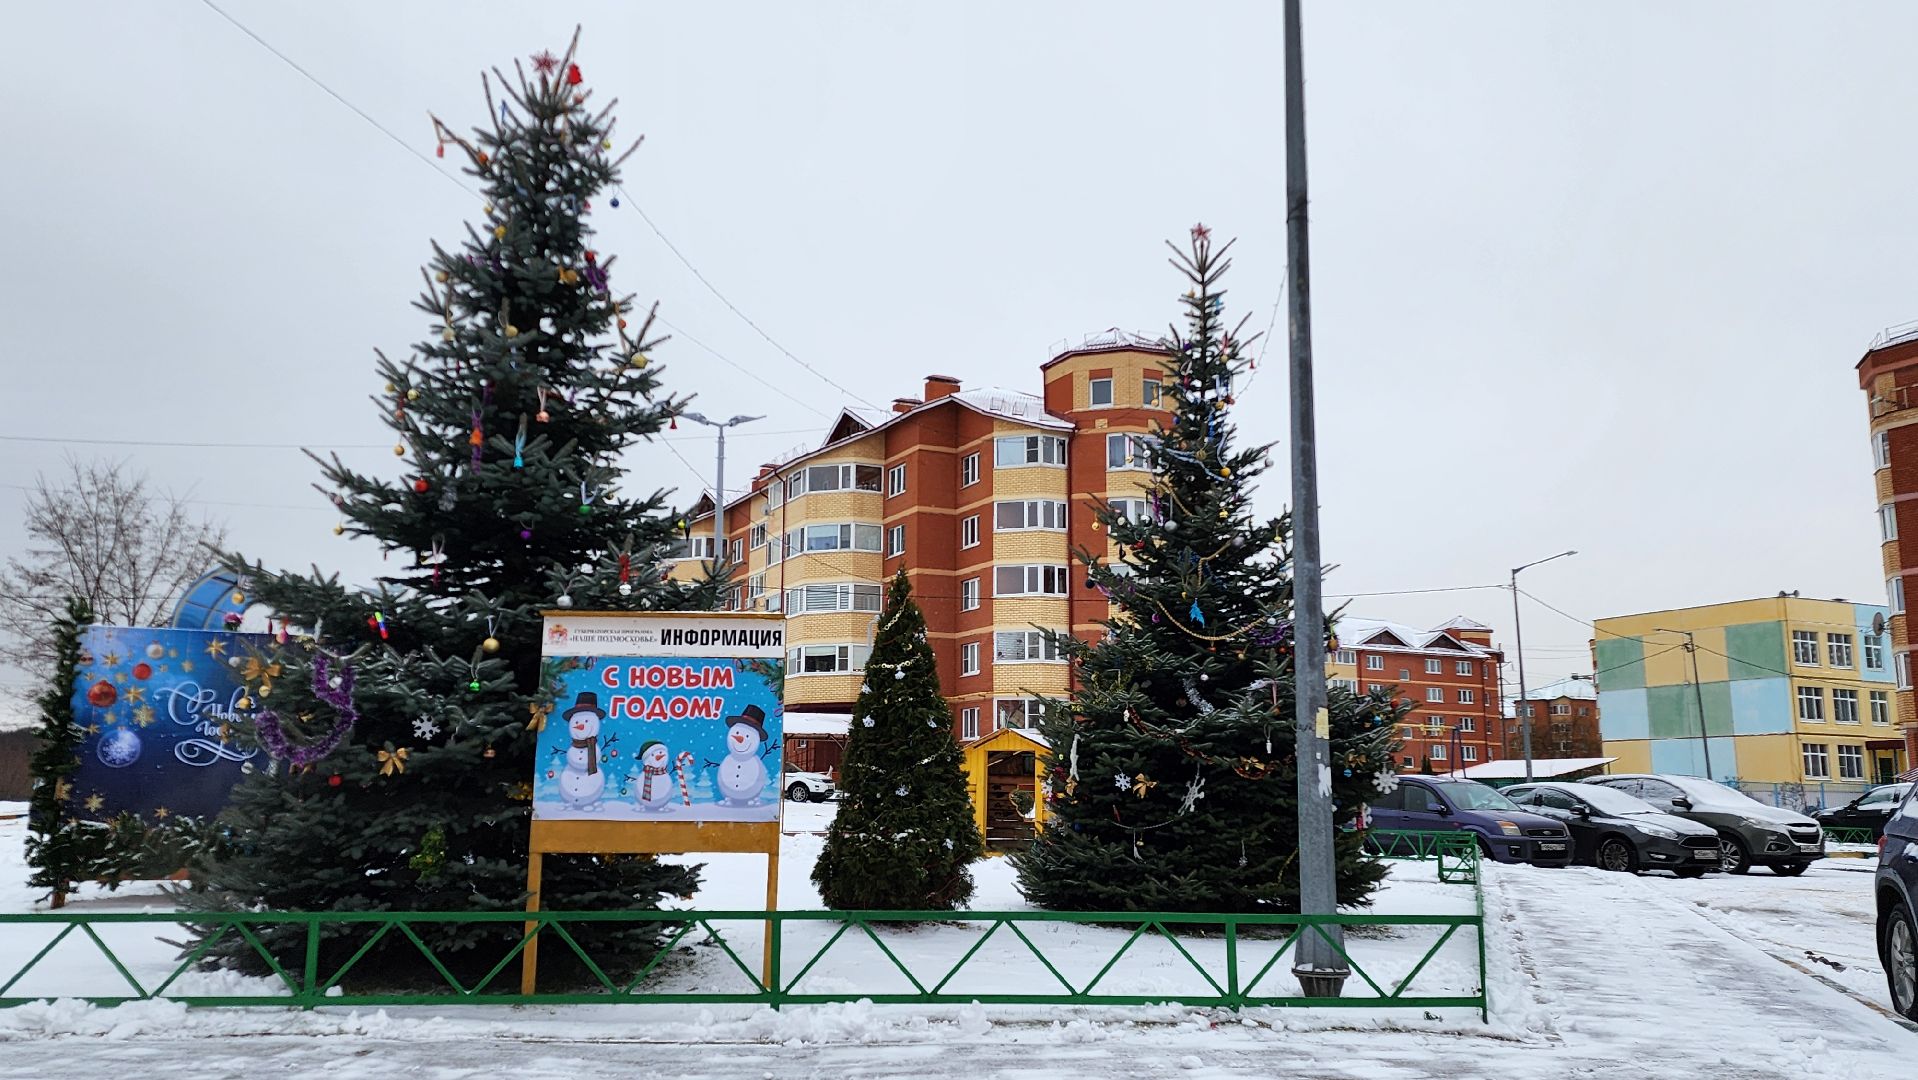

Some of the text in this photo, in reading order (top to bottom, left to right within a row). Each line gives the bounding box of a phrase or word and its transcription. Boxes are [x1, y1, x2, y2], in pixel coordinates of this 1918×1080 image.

[660, 628, 782, 650] ИНФОРМАЦИЯ
[603, 666, 733, 688] С НОВЫМ
[611, 697, 722, 720] ГОДОМ!
